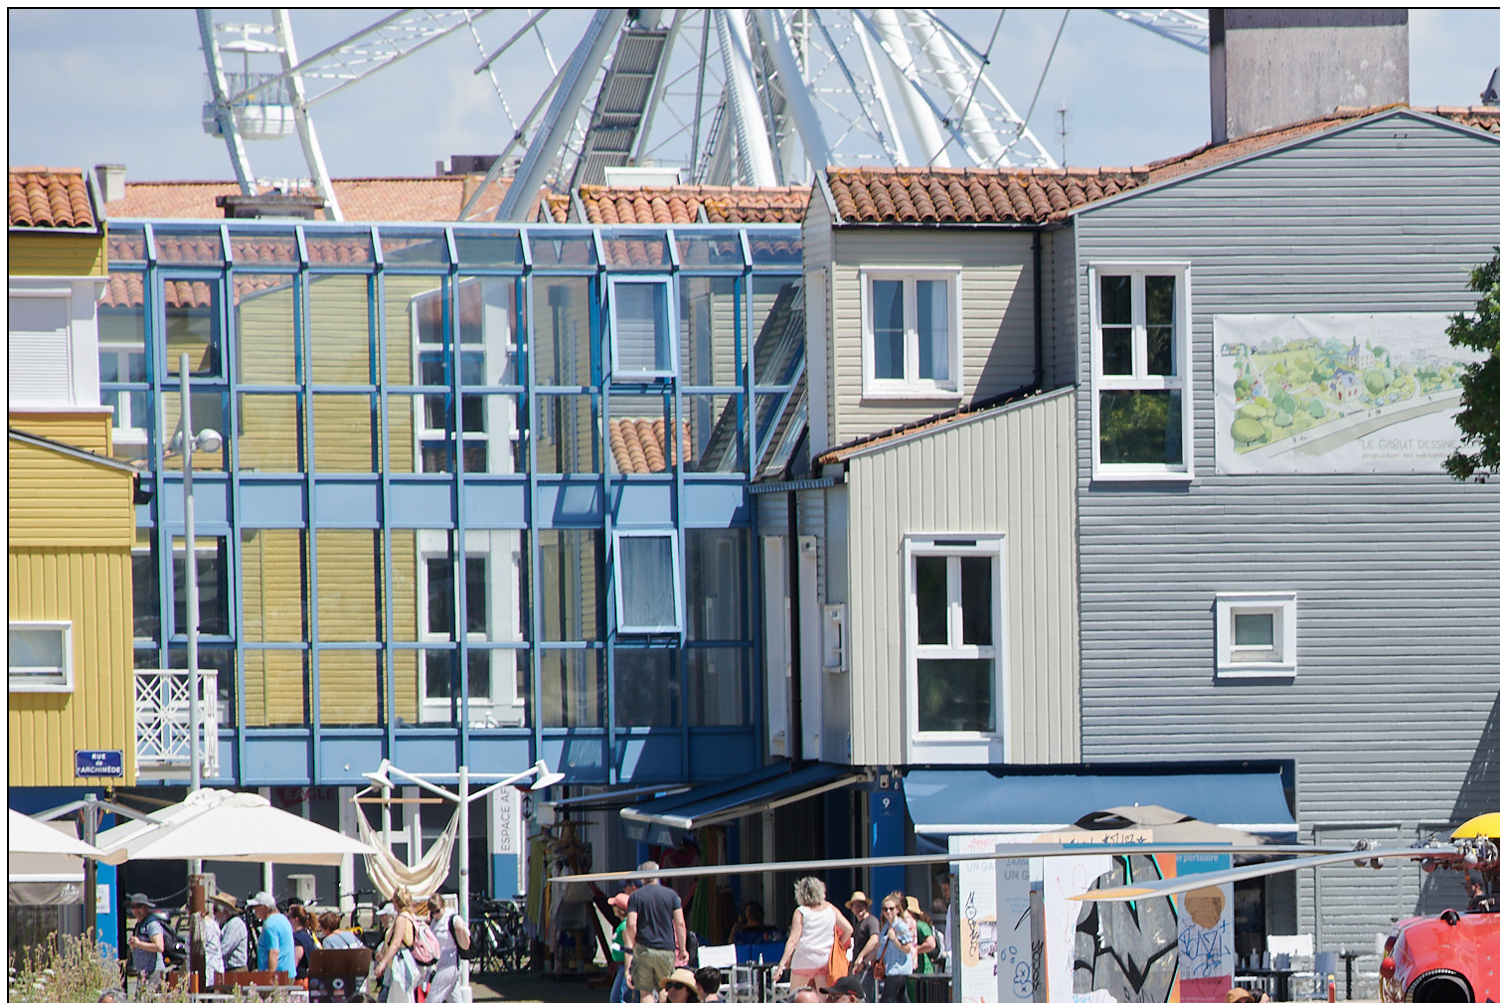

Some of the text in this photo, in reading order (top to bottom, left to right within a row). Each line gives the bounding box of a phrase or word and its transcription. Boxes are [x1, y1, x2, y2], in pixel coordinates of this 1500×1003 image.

[1378, 439, 1414, 450] GABUT
[882, 797, 891, 808] 9
[501, 806, 510, 851] ESPACE
[1183, 854, 1219, 863] portuaire
[1004, 870, 1019, 880] UN
